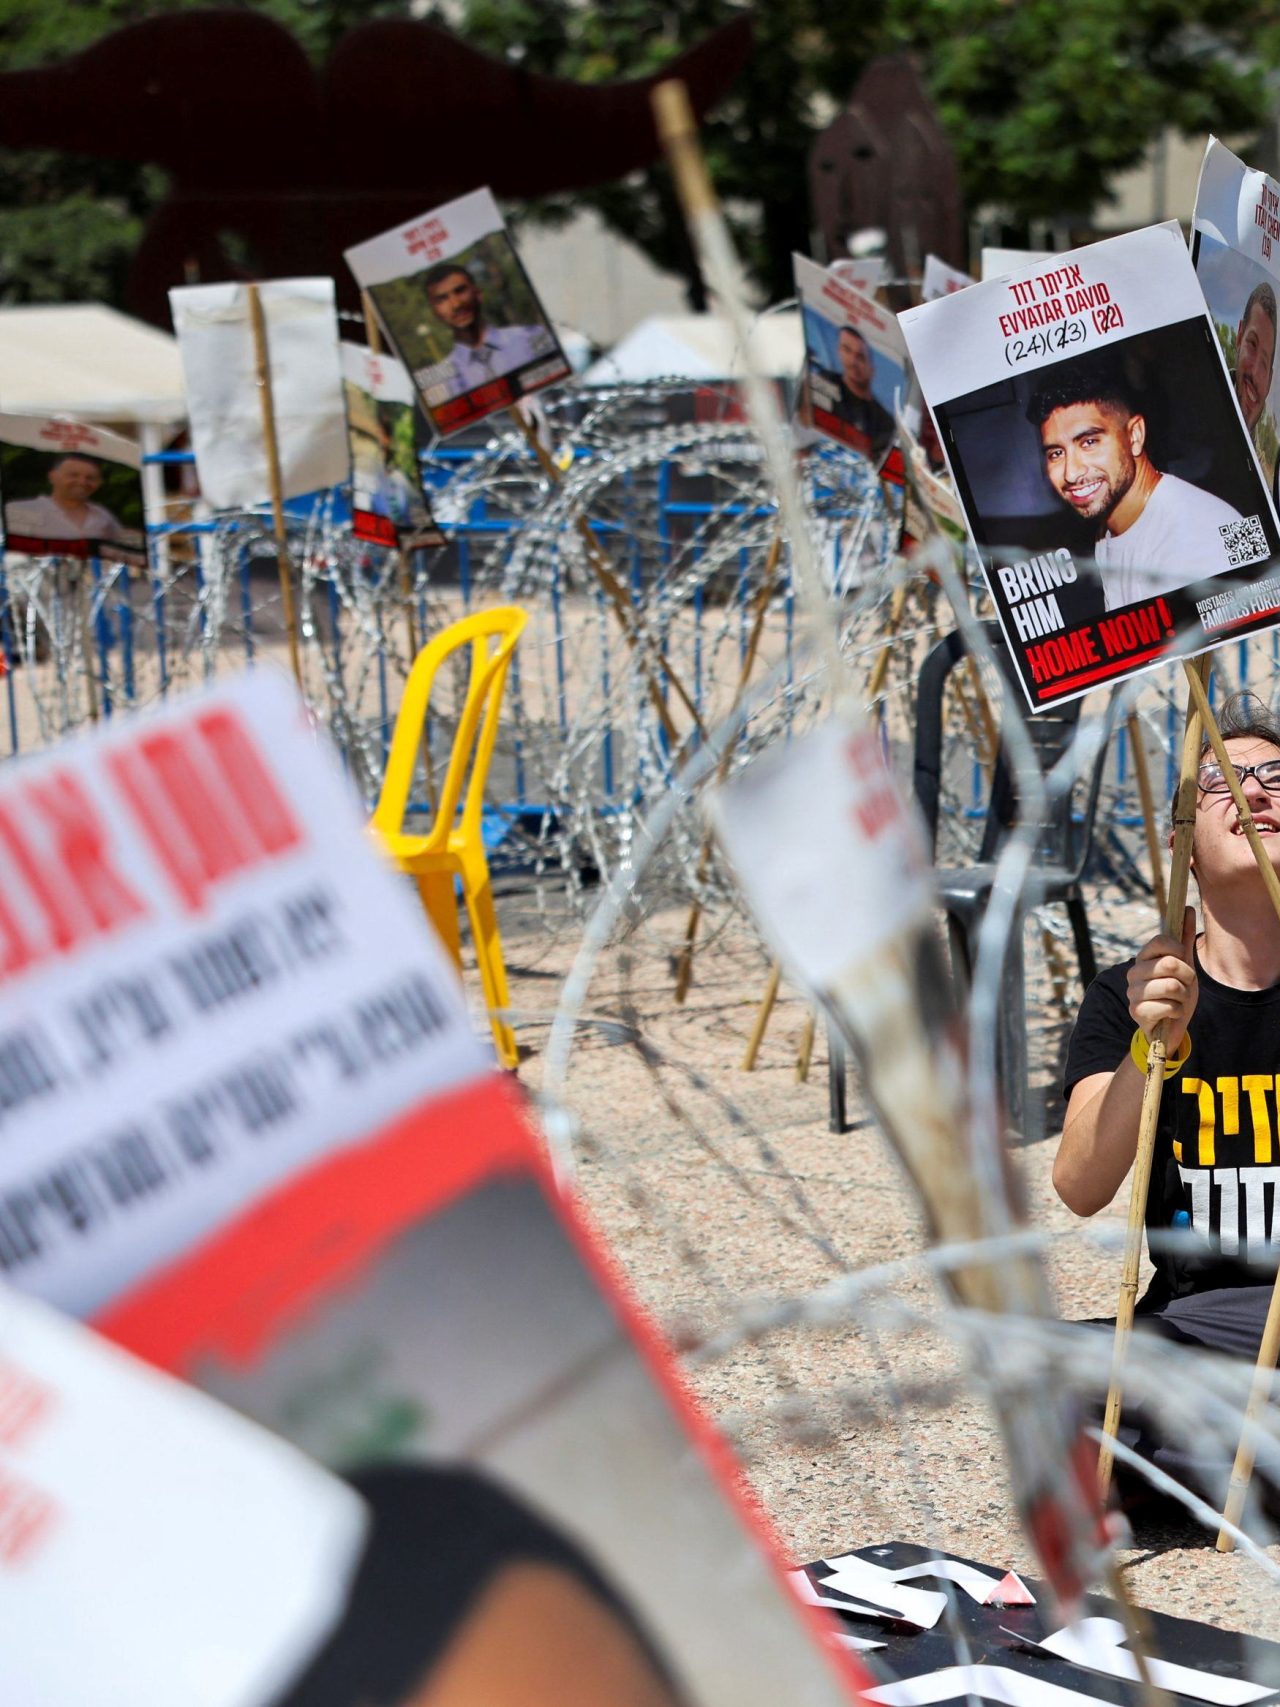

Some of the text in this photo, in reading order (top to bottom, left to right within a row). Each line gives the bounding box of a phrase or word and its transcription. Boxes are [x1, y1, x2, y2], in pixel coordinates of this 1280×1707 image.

[1008, 264, 1084, 306] אביתר דוד
[998, 283, 1111, 338] EVYATAR DAVID
[997, 547, 1078, 605] BRING
[1010, 593, 1066, 643] HIM
[1196, 590, 1234, 614] HOSTAGES
[1200, 602, 1250, 631] FAMILIES
[1025, 597, 1177, 684] HOME NOW!
